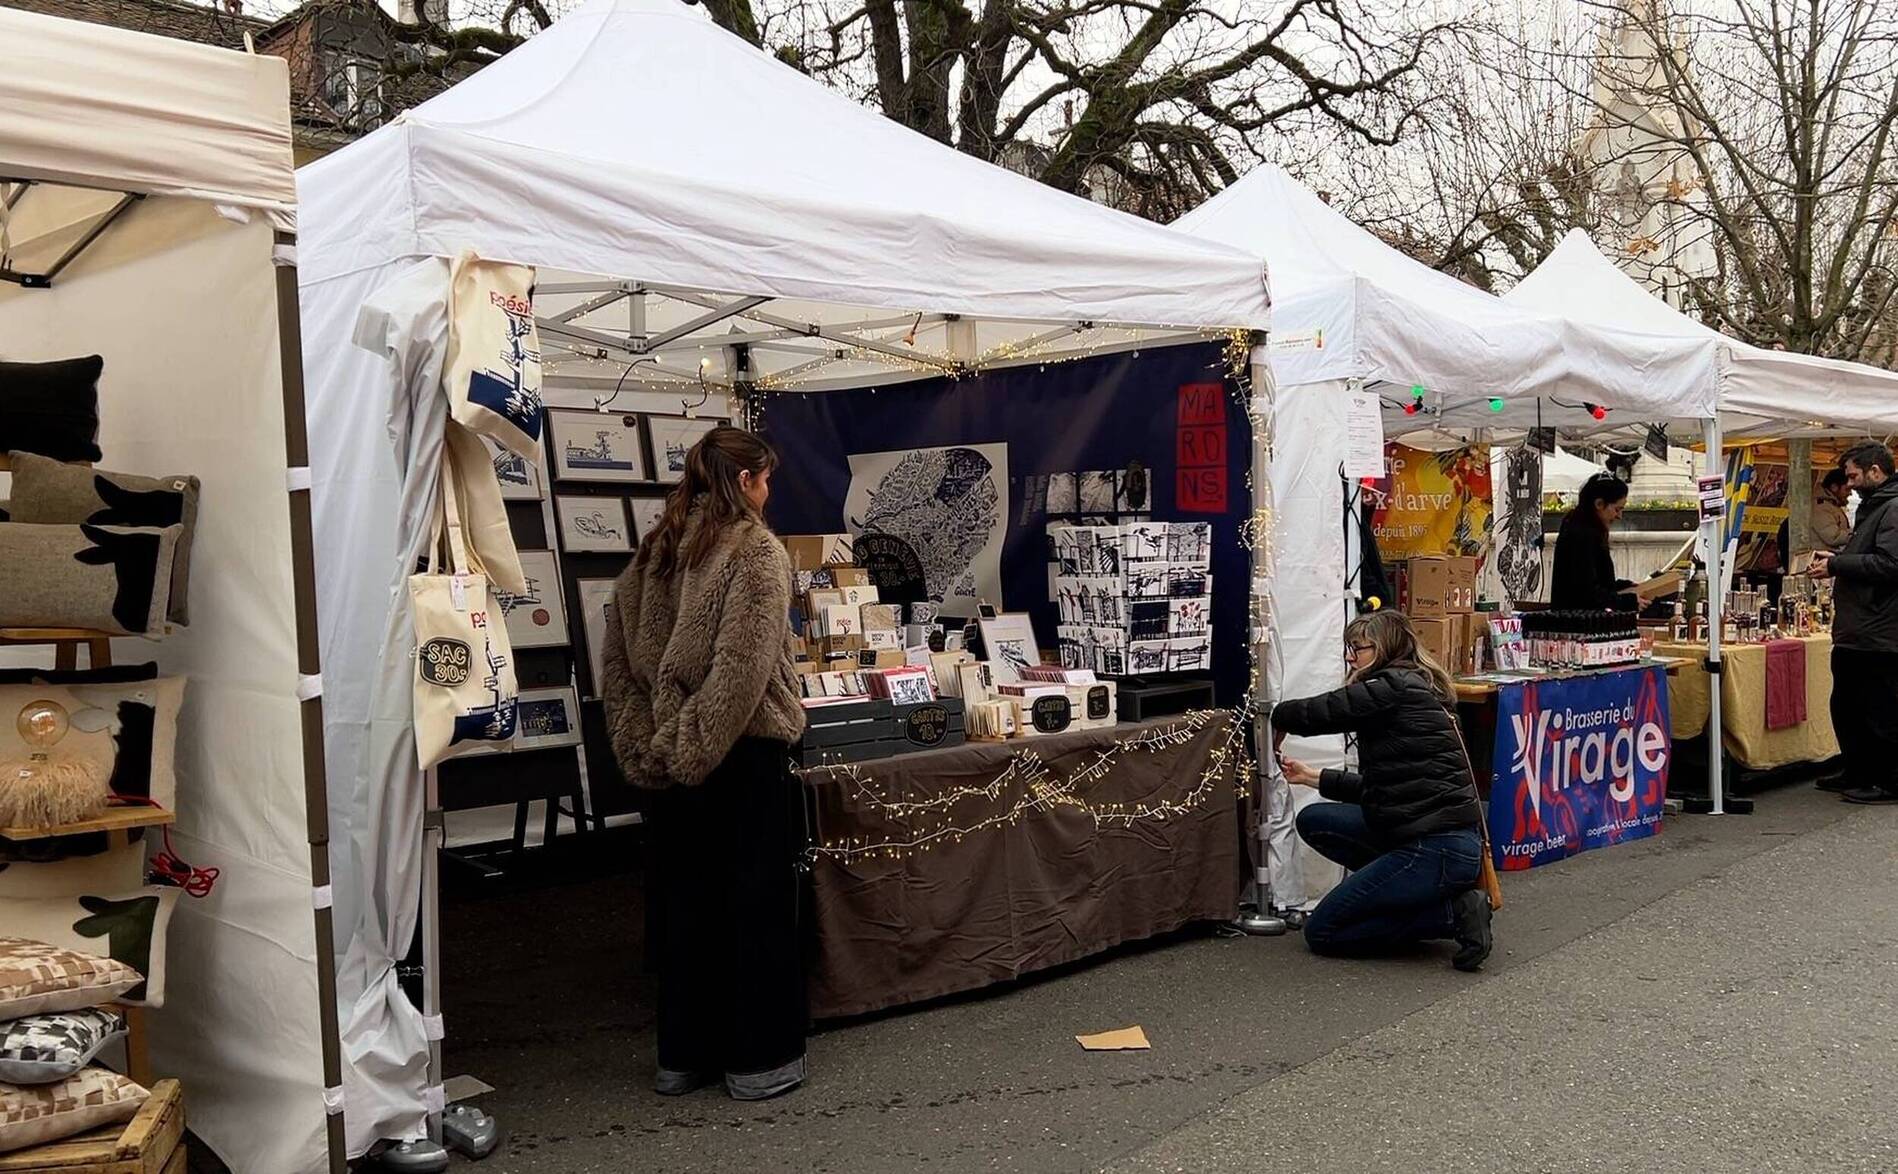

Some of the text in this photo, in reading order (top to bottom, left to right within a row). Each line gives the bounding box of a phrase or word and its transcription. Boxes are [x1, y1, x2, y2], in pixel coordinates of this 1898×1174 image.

[427, 643, 467, 665] SAC
[1565, 697, 1635, 731] Brasserie du
[1510, 709, 1666, 821] Virage
